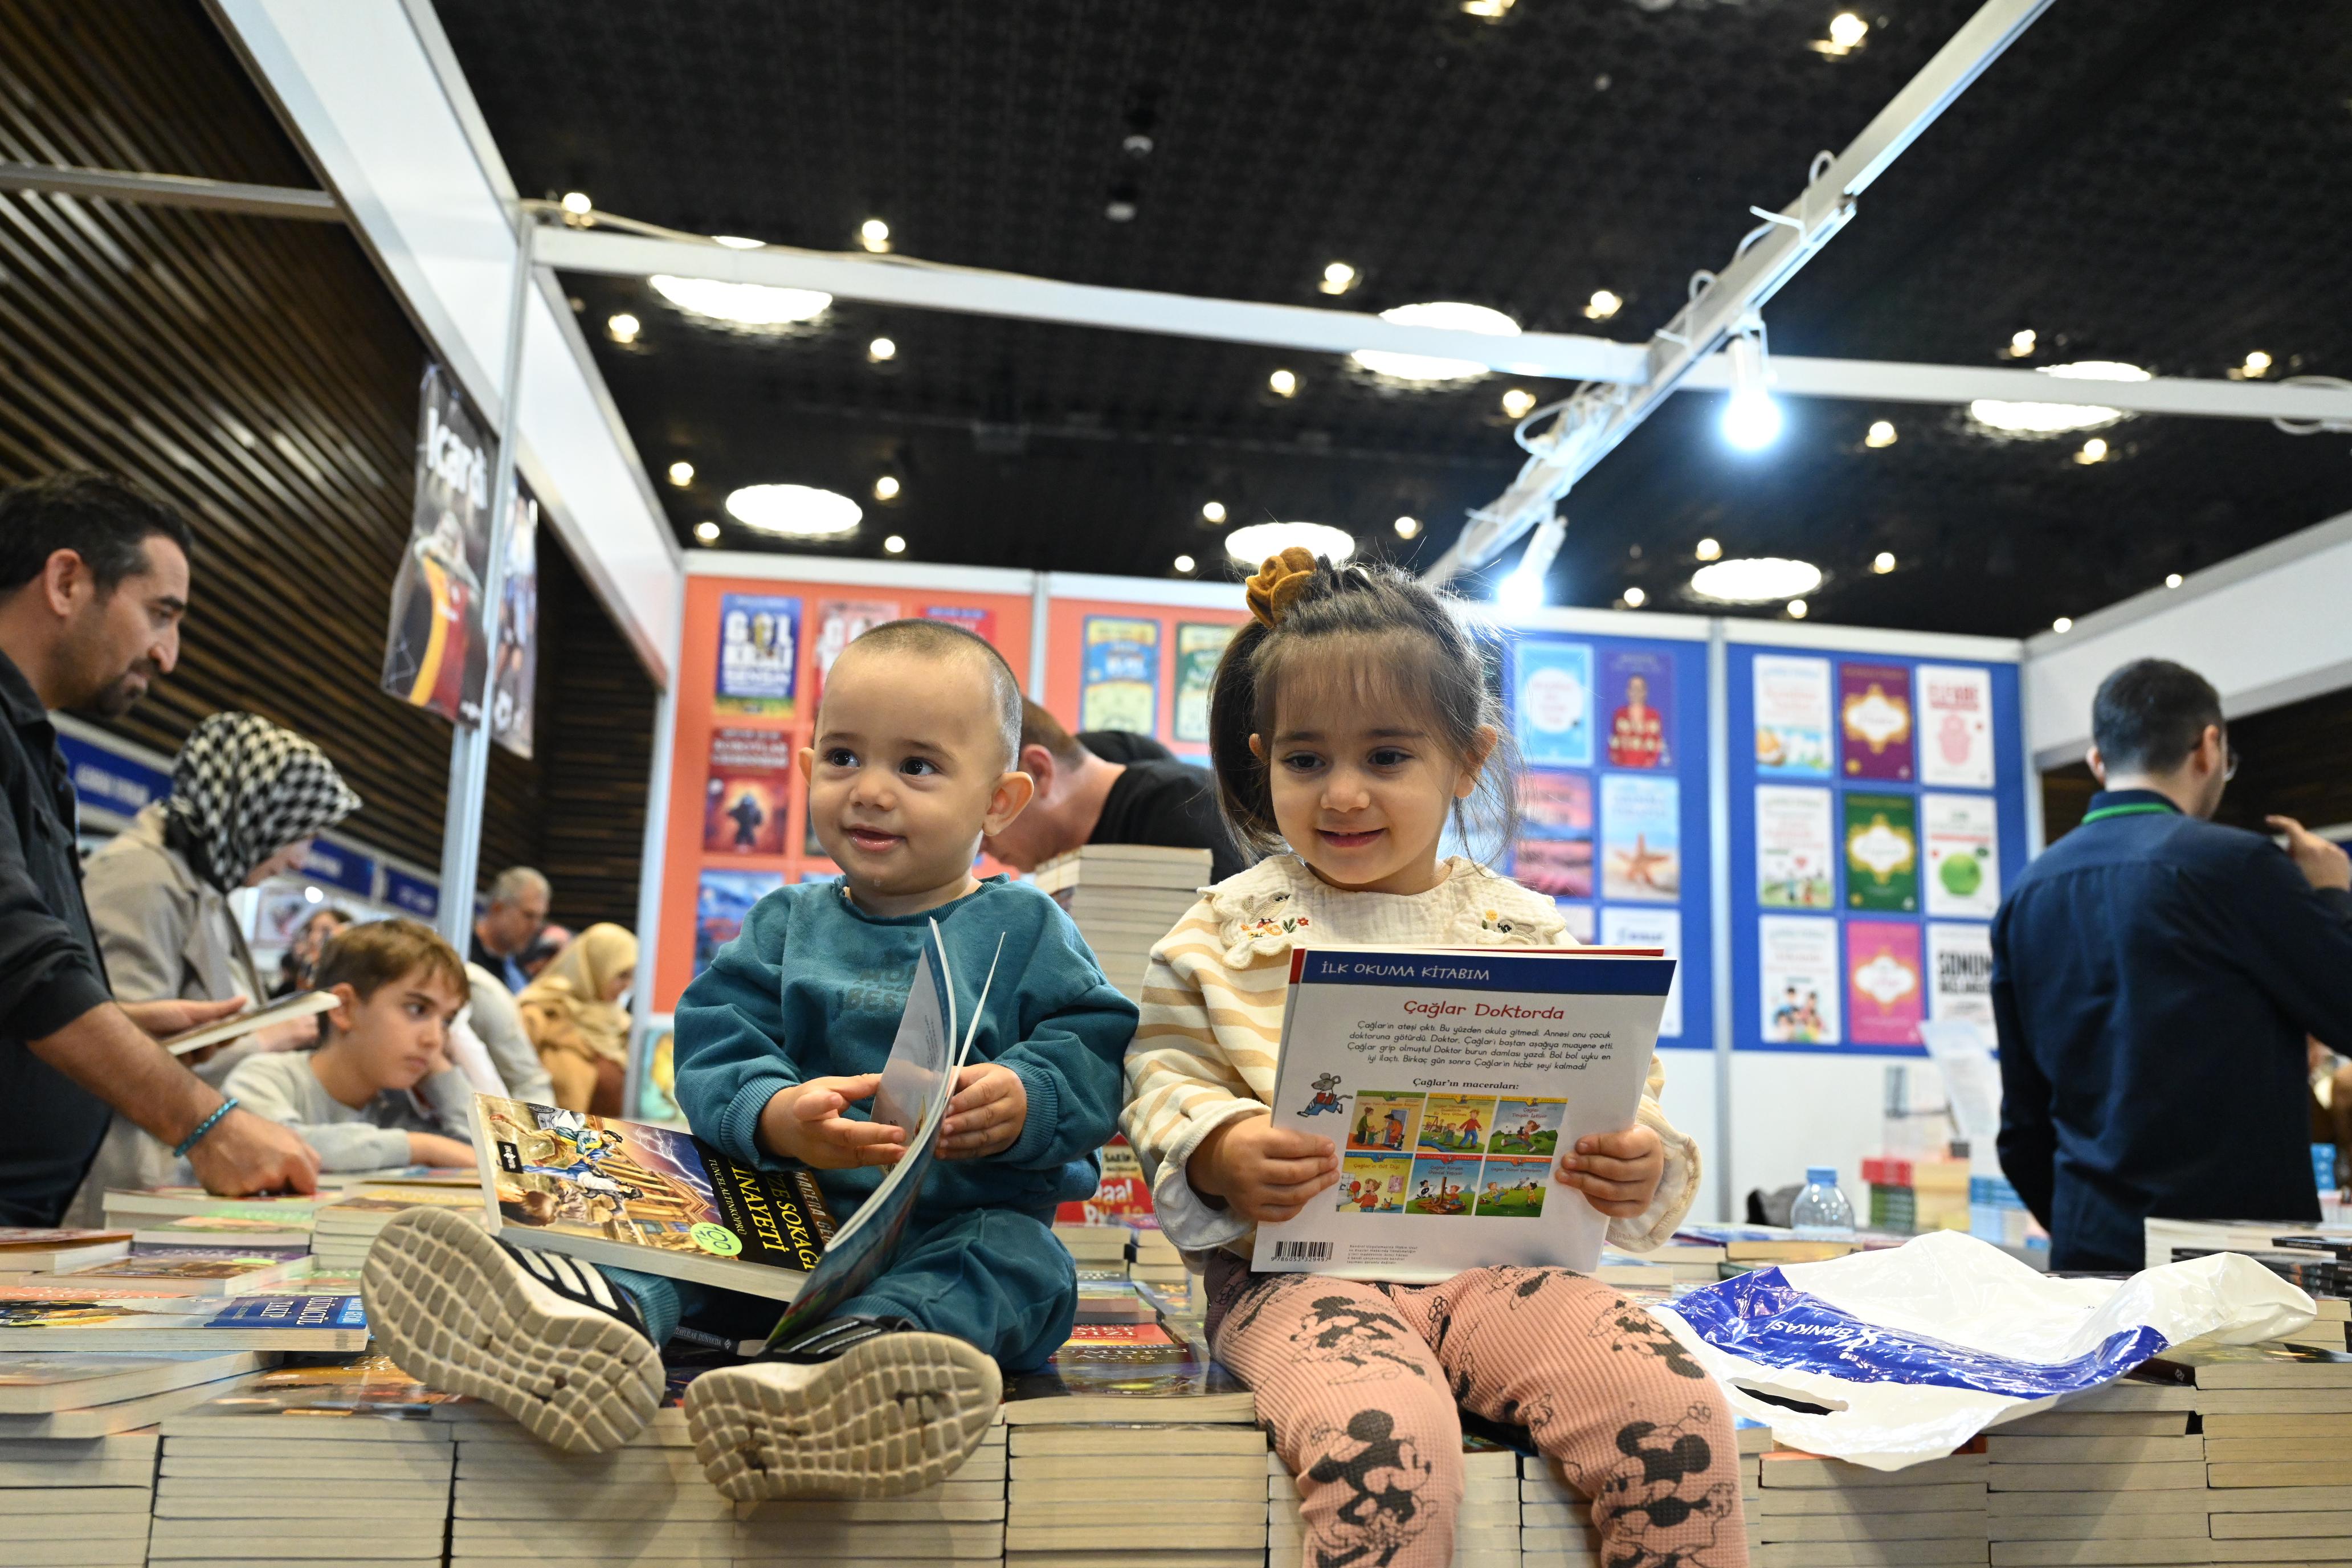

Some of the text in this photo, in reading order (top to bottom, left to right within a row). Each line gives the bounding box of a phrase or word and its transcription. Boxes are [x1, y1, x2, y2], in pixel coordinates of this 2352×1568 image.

[1321, 961, 1489, 980] İLK OKUMA KİTABIM
[1404, 1001, 1565, 1019] Çağlar Doktorda
[1453, 1025, 1481, 1035] yüzden
[1347, 1042, 1376, 1052] Çağlar
[1379, 1044, 1395, 1054] grip
[1434, 1046, 1462, 1054] Doktor
[1465, 1047, 1487, 1055] burun
[1581, 1053, 1599, 1062] uyku
[1498, 1039, 1526, 1048] baştan
[1529, 1042, 1559, 1050] aşağıya
[1367, 1055, 1376, 1063] iyi
[1403, 1055, 1428, 1064] Birkaç
[1513, 1058, 1533, 1068] hiçbir
[1537, 1061, 1551, 1071] şeyi
[709, 1159, 726, 1187] TUNCEL
[728, 1159, 790, 1252] İNAYETİ
[703, 1226, 732, 1251] 100
[261, 1301, 293, 1318] TAKİP
[1766, 1320, 1857, 1338] BANKASI
